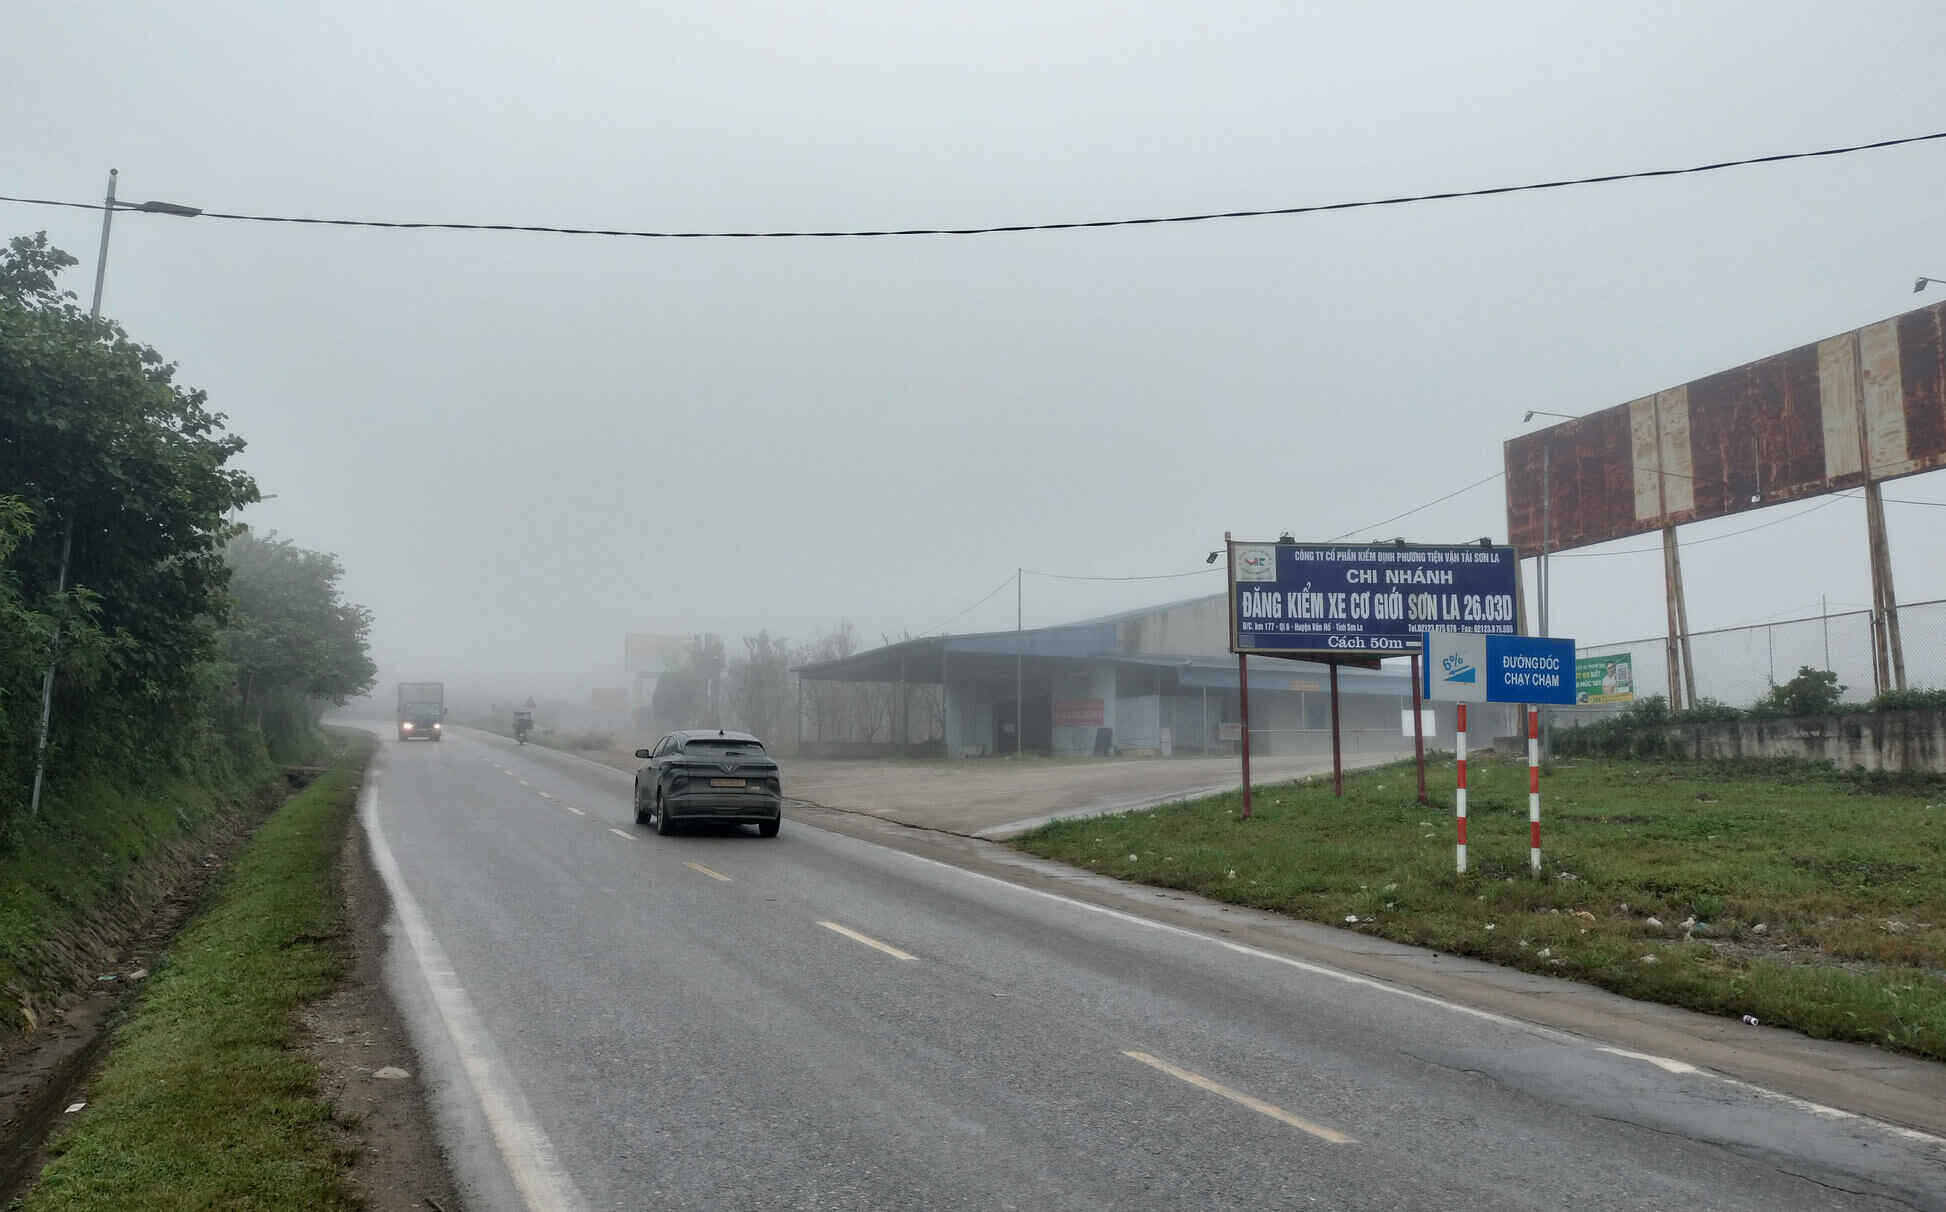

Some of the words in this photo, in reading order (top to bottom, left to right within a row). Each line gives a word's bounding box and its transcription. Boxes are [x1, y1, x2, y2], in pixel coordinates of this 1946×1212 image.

[1315, 552, 1324, 561] TY
[1491, 553, 1500, 563] LA
[1346, 569, 1378, 584] CHI
[1385, 566, 1453, 585] NHÁNH
[1242, 585, 1282, 618] ĐĂNG
[1287, 581, 1324, 618] KIỂM
[1328, 592, 1346, 619] XE
[1350, 591, 1370, 619] CƠ
[1374, 586, 1404, 620] GIỚI
[1407, 591, 1438, 621] SƠN
[1442, 594, 1461, 620] LA
[1463, 594, 1513, 621] 26.03D
[1328, 635, 1366, 649] Cách
[1370, 637, 1403, 649] 50m
[1442, 651, 1464, 671] 6%
[1539, 655, 1560, 670] DỐC
[1504, 672, 1530, 687] CHẠY
